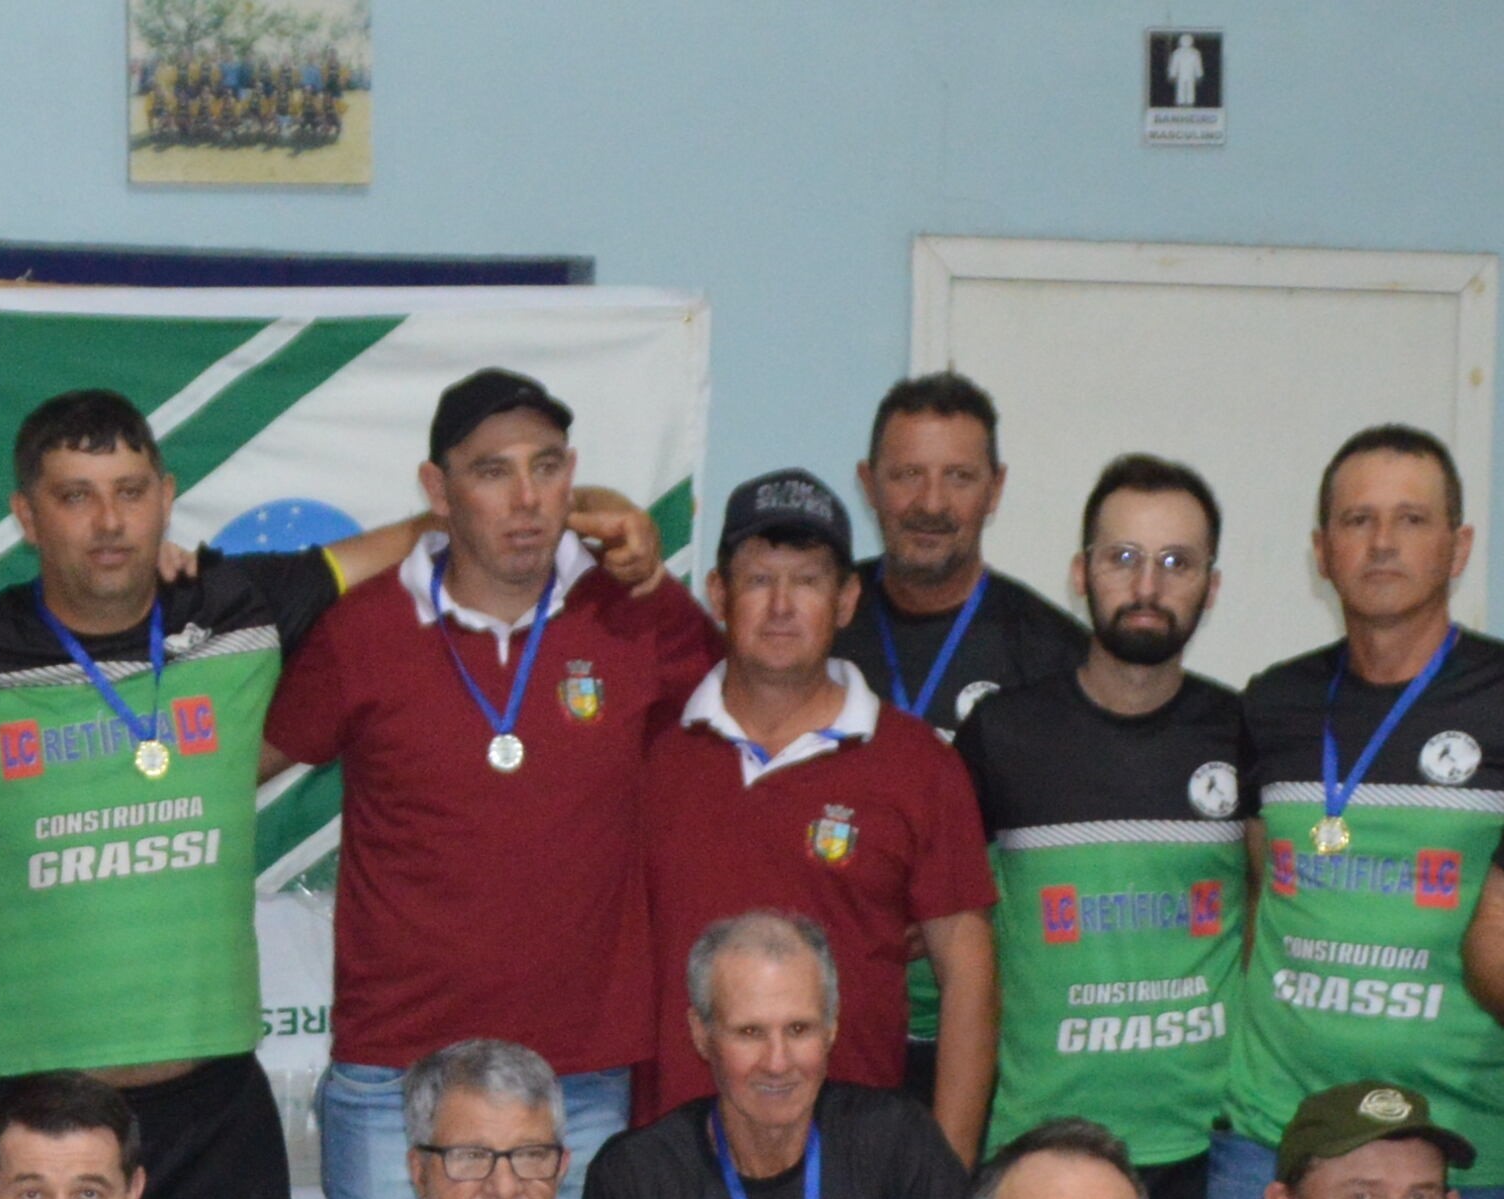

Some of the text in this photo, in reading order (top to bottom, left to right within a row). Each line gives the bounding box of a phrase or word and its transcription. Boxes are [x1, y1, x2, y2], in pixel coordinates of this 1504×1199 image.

[0, 731, 38, 768] LC
[178, 704, 213, 742] LC
[35, 796, 204, 840] CONSTRUTORA
[28, 828, 221, 890] GRASSI
[1420, 860, 1456, 896] LC
[1045, 895, 1074, 931] LC
[1079, 883, 1190, 932] RETÍFICA
[1283, 936, 1430, 971] CONSTRUTORA
[1069, 975, 1209, 1006] CONSTRUTORA
[1273, 969, 1444, 1021] GRASSI
[1057, 1002, 1227, 1054] GRASSI
